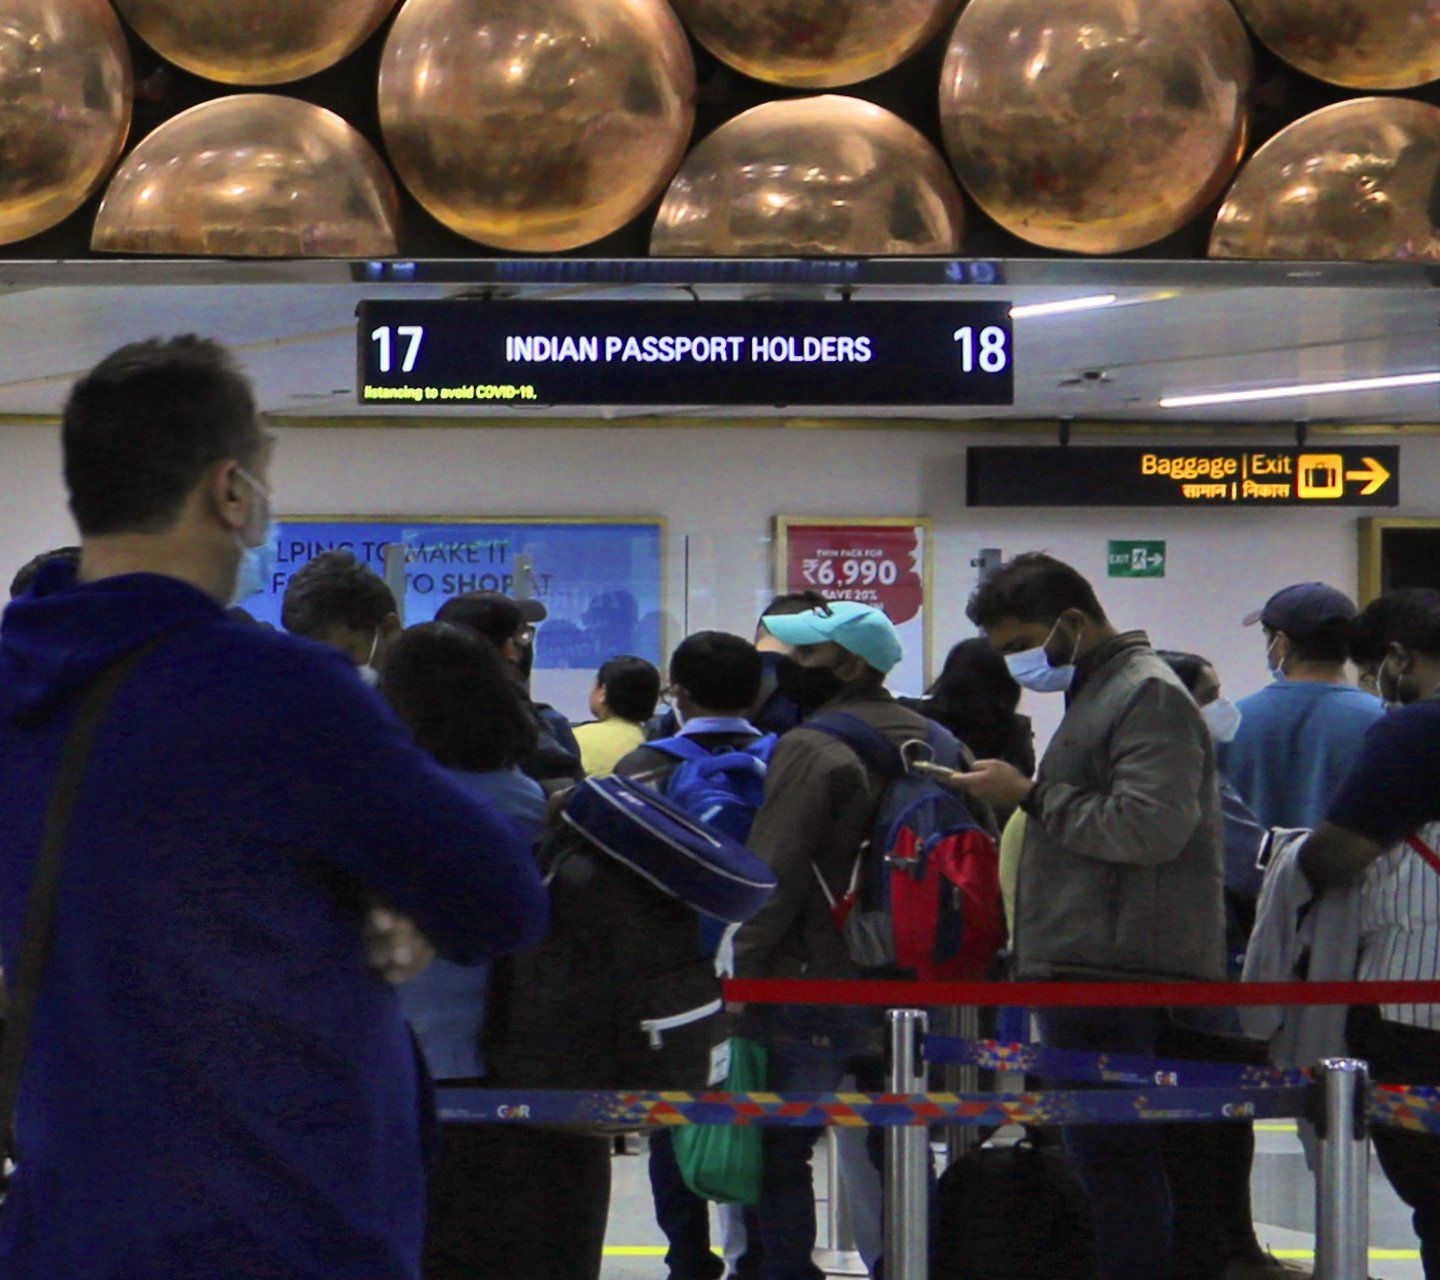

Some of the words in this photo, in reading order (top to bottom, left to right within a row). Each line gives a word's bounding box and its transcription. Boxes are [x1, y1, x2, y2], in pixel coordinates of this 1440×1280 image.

[371, 325, 424, 373] 17
[506, 335, 598, 362] INDIAN
[605, 336, 744, 362] PASSPORT
[752, 336, 872, 362] HOLDERS
[953, 325, 1006, 373] 18
[425, 386, 439, 399] to
[440, 385, 474, 399] avoid
[1142, 454, 1237, 480] Baggage
[1251, 454, 1292, 474] Exit
[1182, 483, 1227, 498] सामान
[1242, 481, 1290, 498] निकास
[407, 543, 479, 563] MAKE
[488, 543, 507, 562] IT
[821, 589, 851, 600] SAVE
[855, 589, 878, 600] 20%
